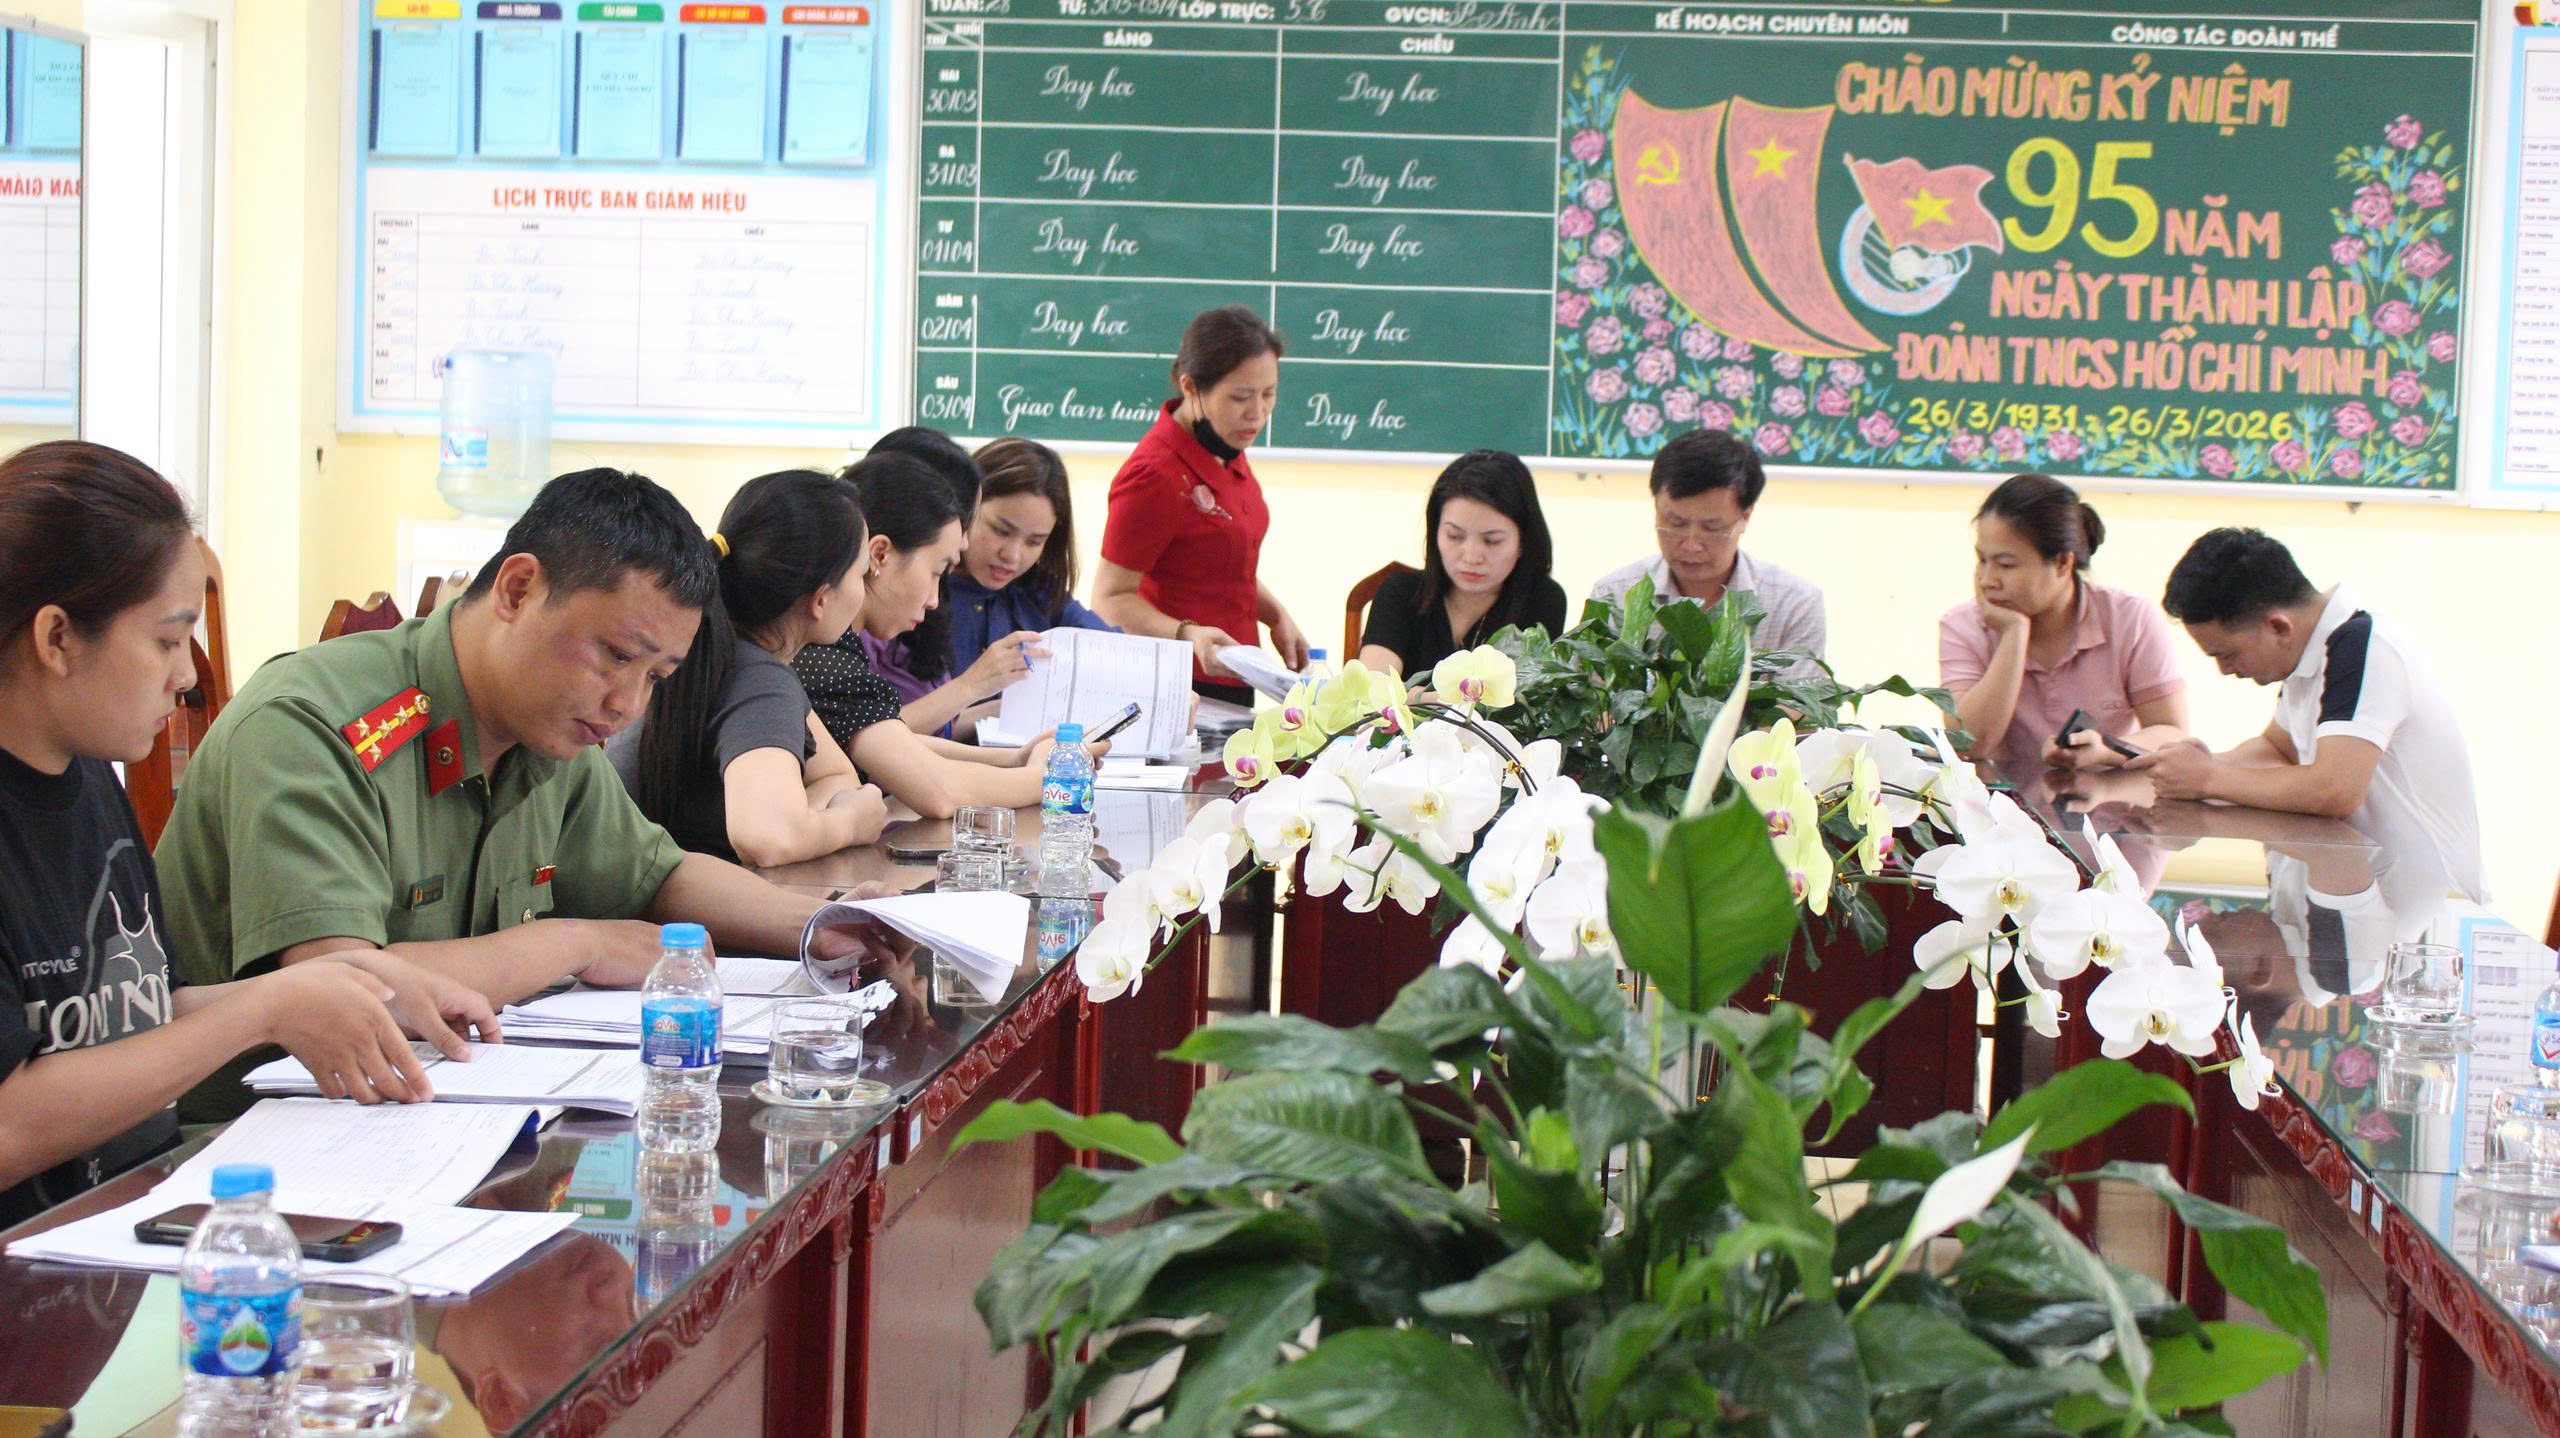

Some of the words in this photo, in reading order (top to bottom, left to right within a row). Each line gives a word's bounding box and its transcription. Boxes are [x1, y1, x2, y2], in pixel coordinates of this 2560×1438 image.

[1385, 5, 1450, 24] GVCN:
[1655, 8, 1683, 31] KẾ
[1684, 13, 1763, 36] HOẠCH
[1768, 12, 1854, 35] CHUYÊN
[1857, 12, 1910, 35] MÔN
[2110, 21, 2179, 44] CÔNG
[2183, 22, 2226, 46] TÁC
[2230, 26, 2297, 48] ĐOÀN
[2300, 23, 2341, 49] THỂ
[1102, 28, 1153, 48] SÁNG
[1400, 32, 1455, 54] CHIỀU
[1961, 54, 2092, 121] MỪNG
[2097, 52, 2161, 121] KỶ
[2167, 62, 2291, 136] NIỆM
[493, 187, 537, 212] LỊCH
[543, 188, 593, 213] TRỰC
[600, 190, 638, 210] BAN
[645, 186, 694, 211] GIÁM
[702, 190, 747, 214] HIỆU
[2003, 136, 2160, 258] 95
[2164, 194, 2282, 260] NĂM
[1989, 259, 2114, 321] NGÀY
[2118, 263, 2280, 327] THÀNH
[2287, 265, 2367, 341] LẬP
[1893, 321, 2000, 382] ĐOÀN
[2006, 336, 2118, 390] TNCS
[2122, 324, 2193, 390] HỒ
[2188, 328, 2262, 393] CHÍ
[2268, 345, 2391, 398] MINH
[997, 383, 1054, 432] Giao
[1060, 387, 1105, 421] ban
[1304, 393, 1360, 440] Dạy
[1907, 398, 2079, 433] 26/3/1931
[2105, 404, 2294, 442] 26/3/2026
